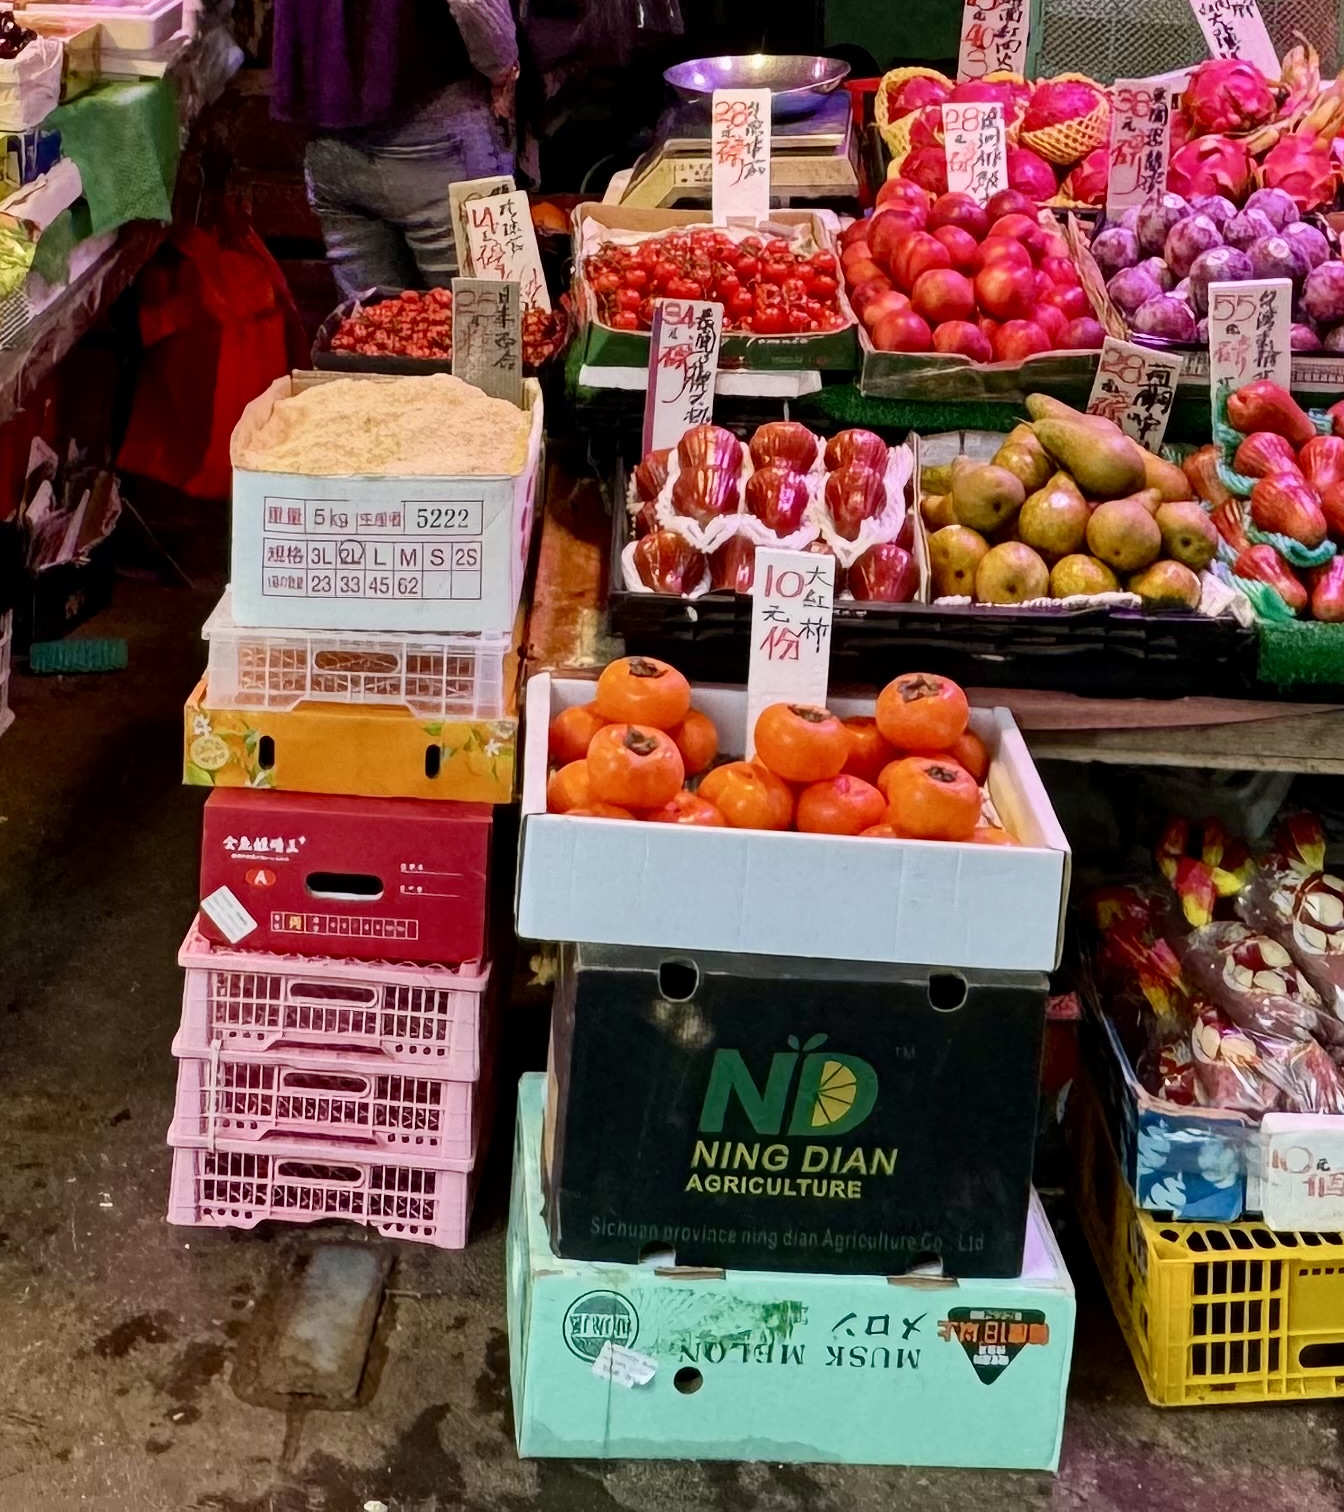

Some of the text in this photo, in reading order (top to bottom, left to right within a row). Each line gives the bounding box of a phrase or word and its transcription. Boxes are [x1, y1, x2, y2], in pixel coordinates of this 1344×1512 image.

[945, 107, 980, 132] 28
[1213, 294, 1257, 322] 55
[415, 508, 471, 530] 5222
[309, 546, 334, 566] 3L
[373, 546, 388, 567] L
[399, 546, 418, 568] M
[429, 547, 446, 568] S
[454, 547, 479, 568] 2S
[310, 574, 333, 594] 23
[339, 574, 362, 594] 33
[368, 576, 391, 595] 45
[397, 577, 420, 596] 62
[764, 565, 805, 598] 10
[760, 626, 801, 661] 份
[689, 1139, 900, 1177] NING DIAN
[683, 1173, 863, 1200] AGRICULTURE
[740, 1226, 778, 1251] ning
[783, 1227, 820, 1248] dian
[821, 1227, 916, 1253] Agriculture
[830, 1311, 929, 1341] メロン
[825, 1344, 922, 1370] MUSK
